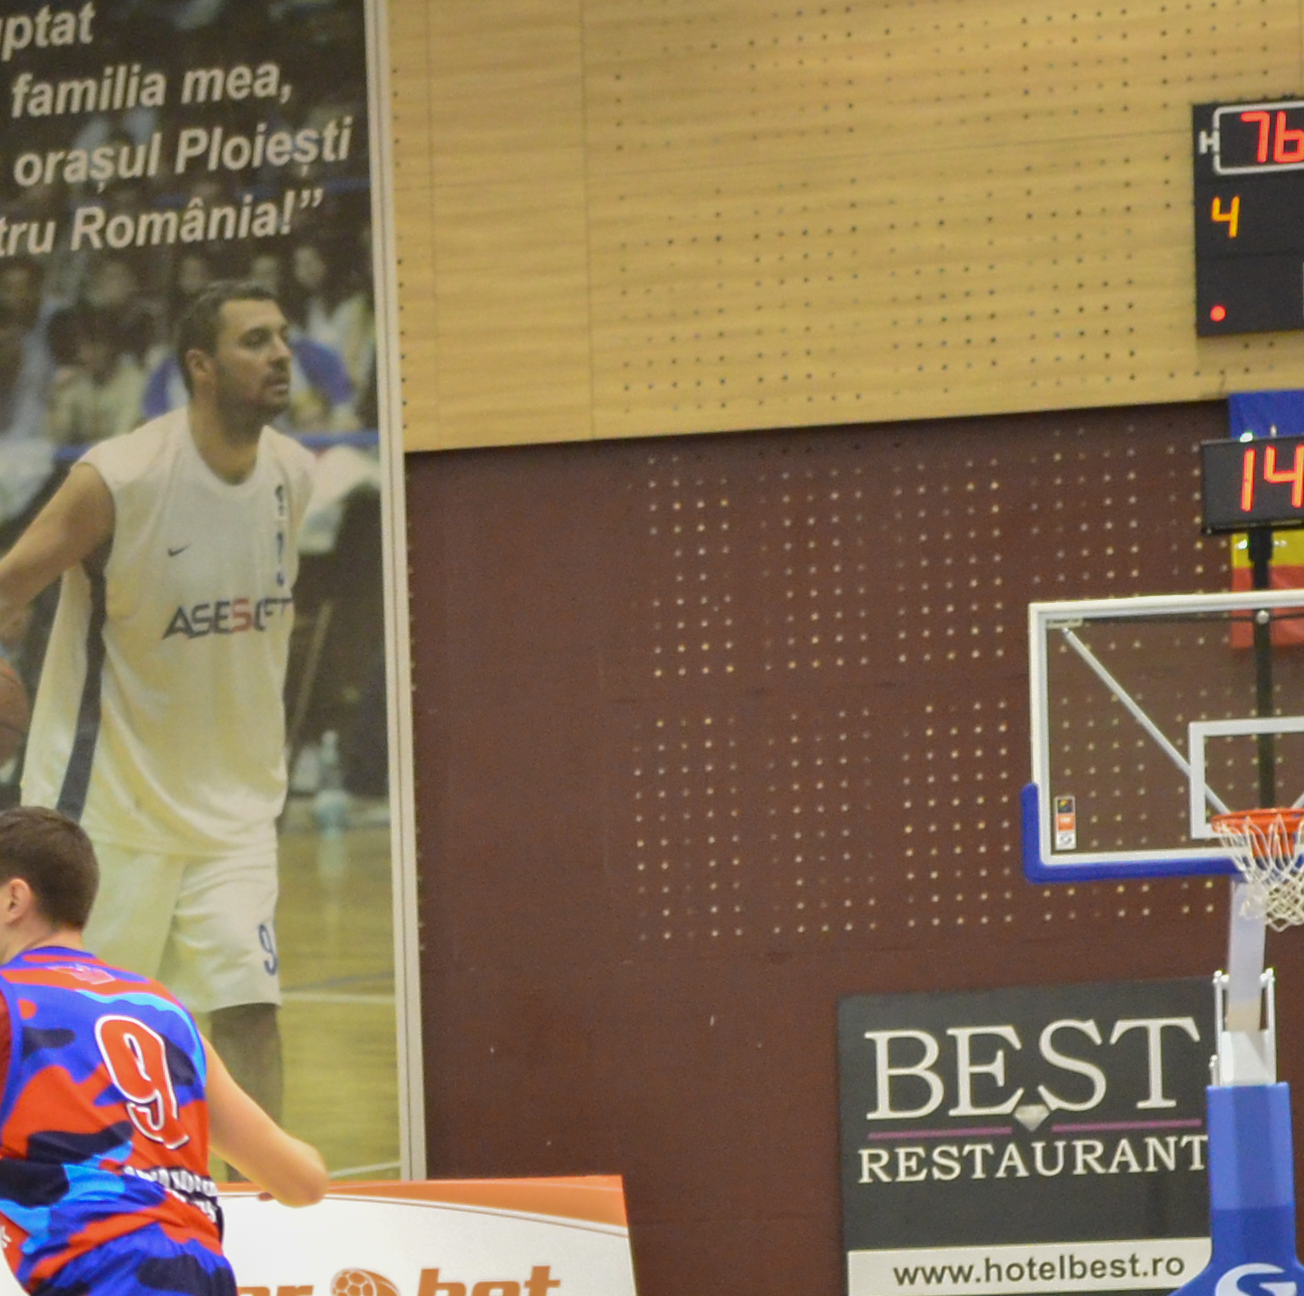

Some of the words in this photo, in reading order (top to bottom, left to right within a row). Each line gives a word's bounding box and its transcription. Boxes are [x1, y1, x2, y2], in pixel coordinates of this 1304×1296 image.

[11, 66, 166, 117] familia
[181, 61, 292, 104] mea,
[13, 133, 161, 193] orașul
[175, 117, 353, 175] Ploiești
[1211, 196, 1240, 238] 4
[1241, 444, 1304, 512] 14
[94, 1014, 189, 1149] 9
[864, 1016, 1201, 1121] BEST
[858, 1134, 1209, 1184] RESTAURANT
[893, 1253, 1186, 1287] www.hotelbest.ro
